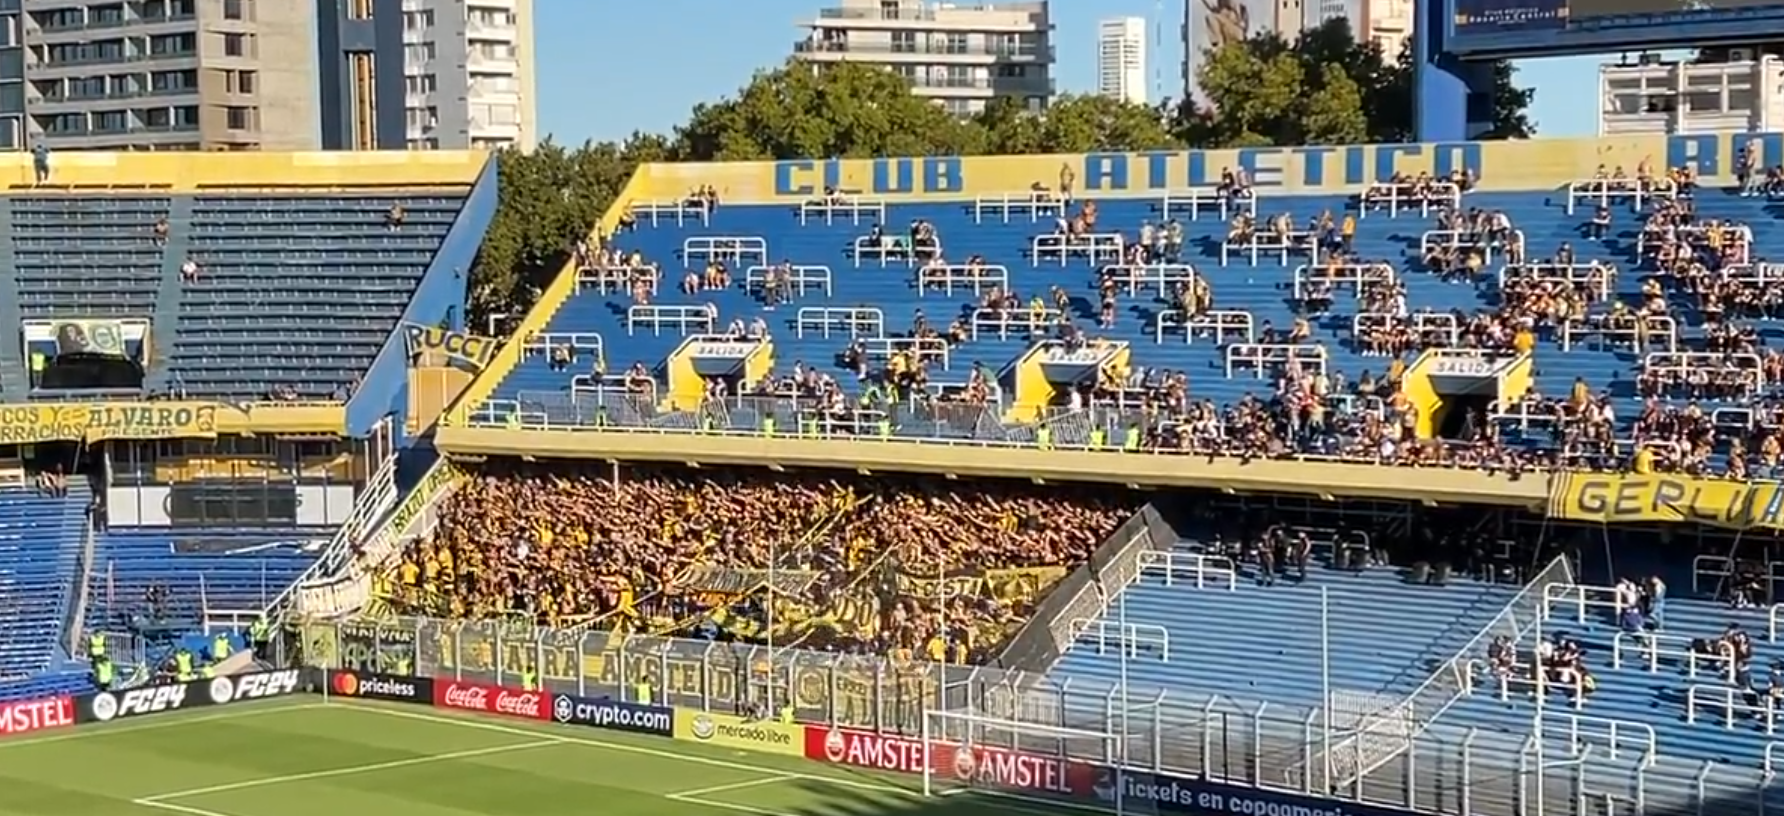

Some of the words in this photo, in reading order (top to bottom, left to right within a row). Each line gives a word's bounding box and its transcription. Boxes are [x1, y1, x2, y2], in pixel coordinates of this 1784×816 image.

[775, 157, 963, 195] CLUB
[1085, 143, 1482, 190] ATLETICO
[699, 346, 744, 355] SALIDA
[86, 407, 192, 428] ALVARO
[234, 670, 299, 699] FC24
[360, 678, 415, 697] priceless
[119, 684, 187, 716] FC24
[576, 703, 670, 730] crypto.com
[717, 724, 766, 742] mercado
[766, 728, 791, 744] libre
[979, 752, 1072, 794] AMSTEL
[1118, 774, 1192, 804] Tickets
[1198, 791, 1223, 810] en
